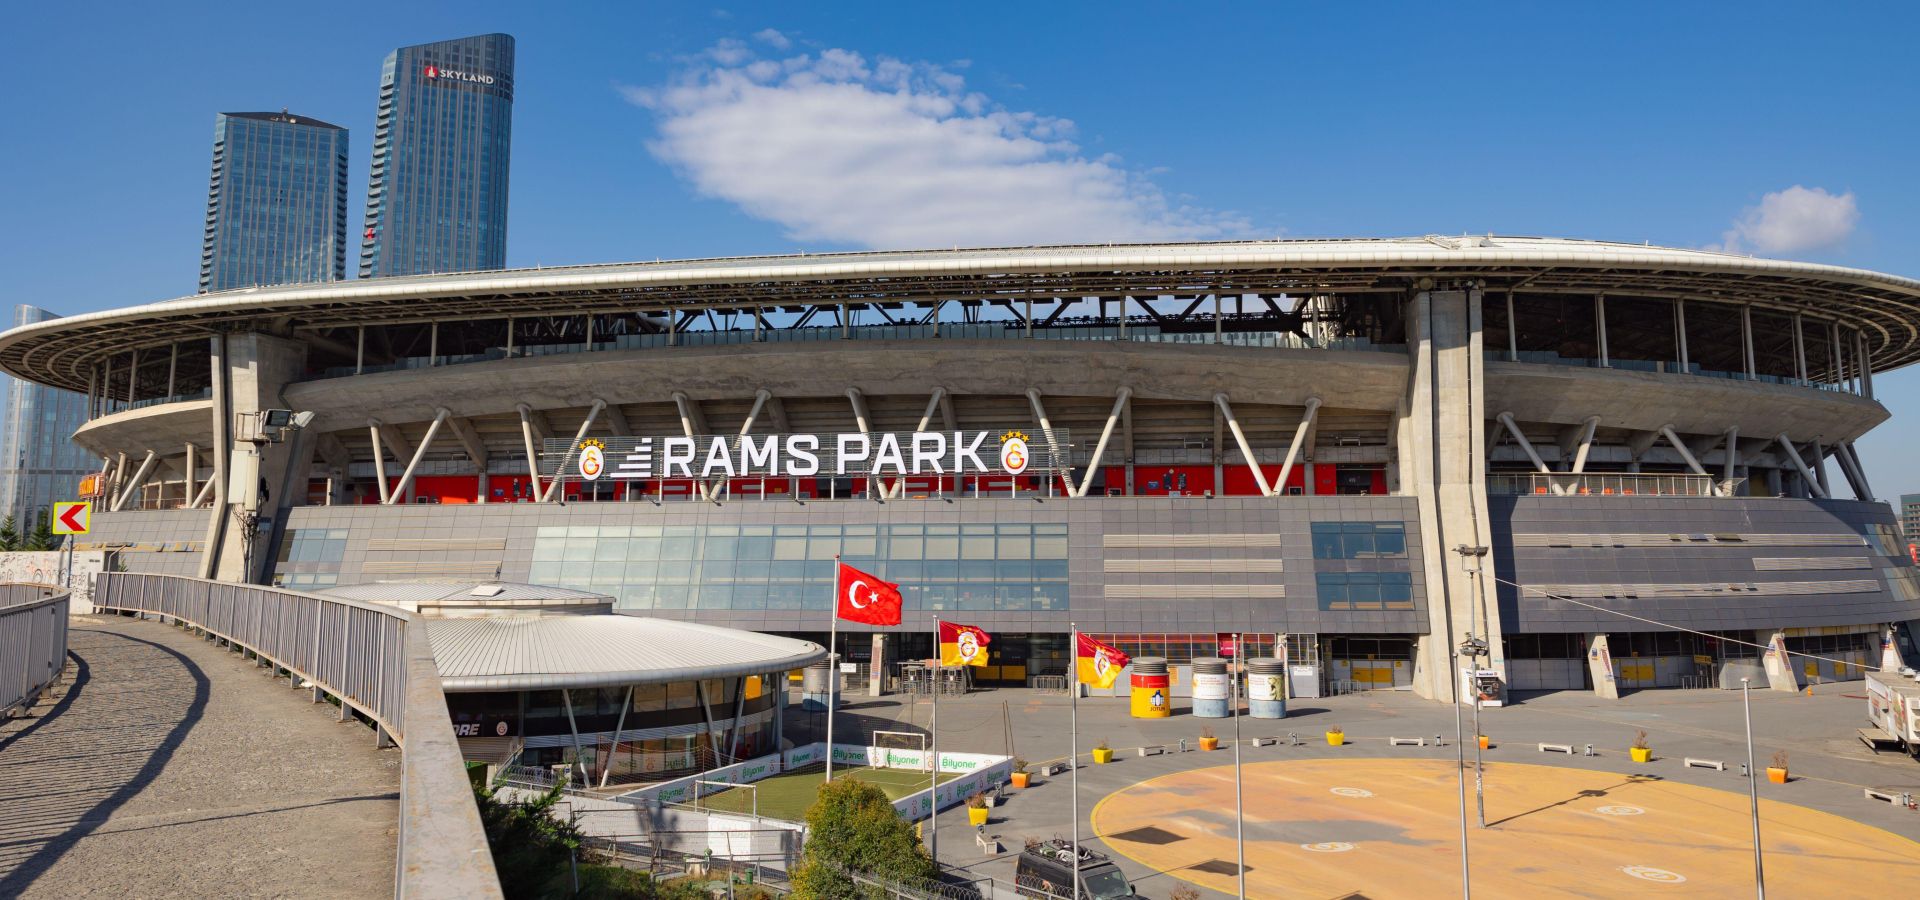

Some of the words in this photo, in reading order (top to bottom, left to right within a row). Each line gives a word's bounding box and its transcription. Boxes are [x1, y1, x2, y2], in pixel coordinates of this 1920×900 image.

[440, 69, 494, 84] SKYLAND
[663, 434, 819, 477] RAMS
[837, 431, 989, 475] PARK
[833, 747, 865, 760] Bilyoner
[887, 754, 919, 765] Bilyoner
[942, 757, 976, 769] Bilyoner
[742, 765, 766, 779] Bilyoner
[956, 781, 976, 798] Bilyoner
